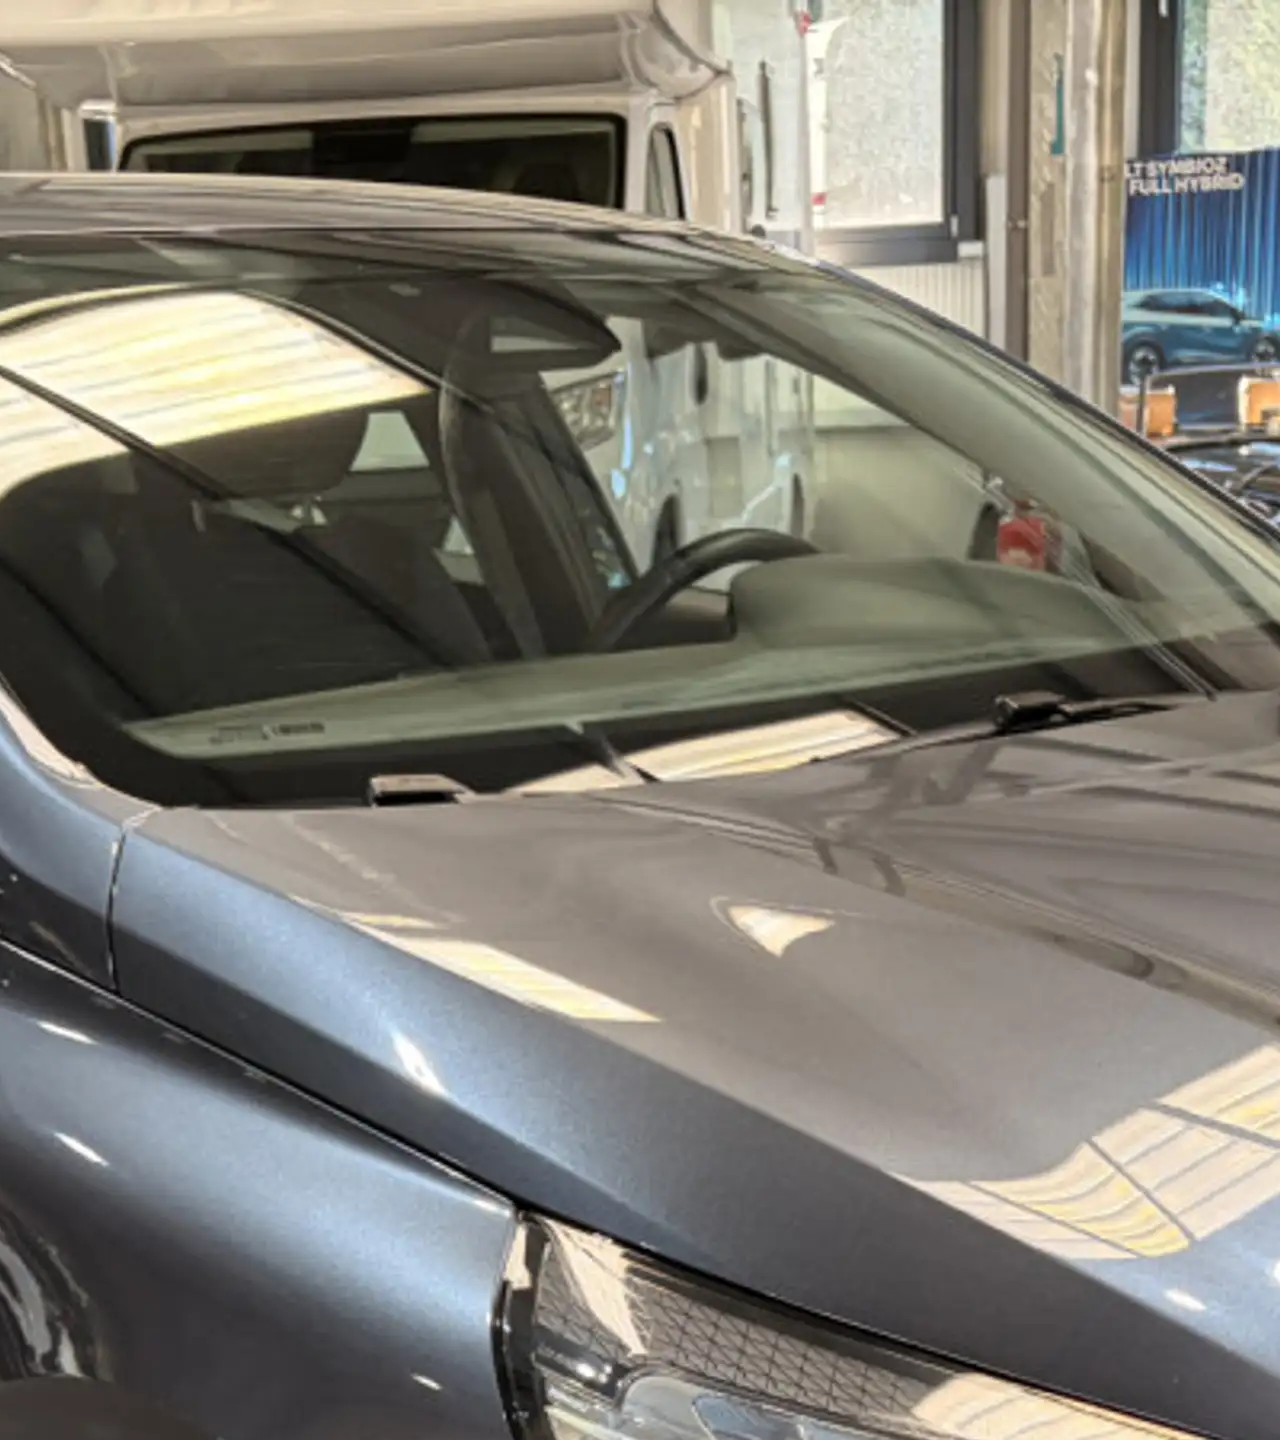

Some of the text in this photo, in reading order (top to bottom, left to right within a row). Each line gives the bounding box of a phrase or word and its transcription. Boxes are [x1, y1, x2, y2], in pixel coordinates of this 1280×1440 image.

[1146, 157, 1228, 178] SYMBIOZ
[1129, 173, 1245, 196] FULL HYBRID
